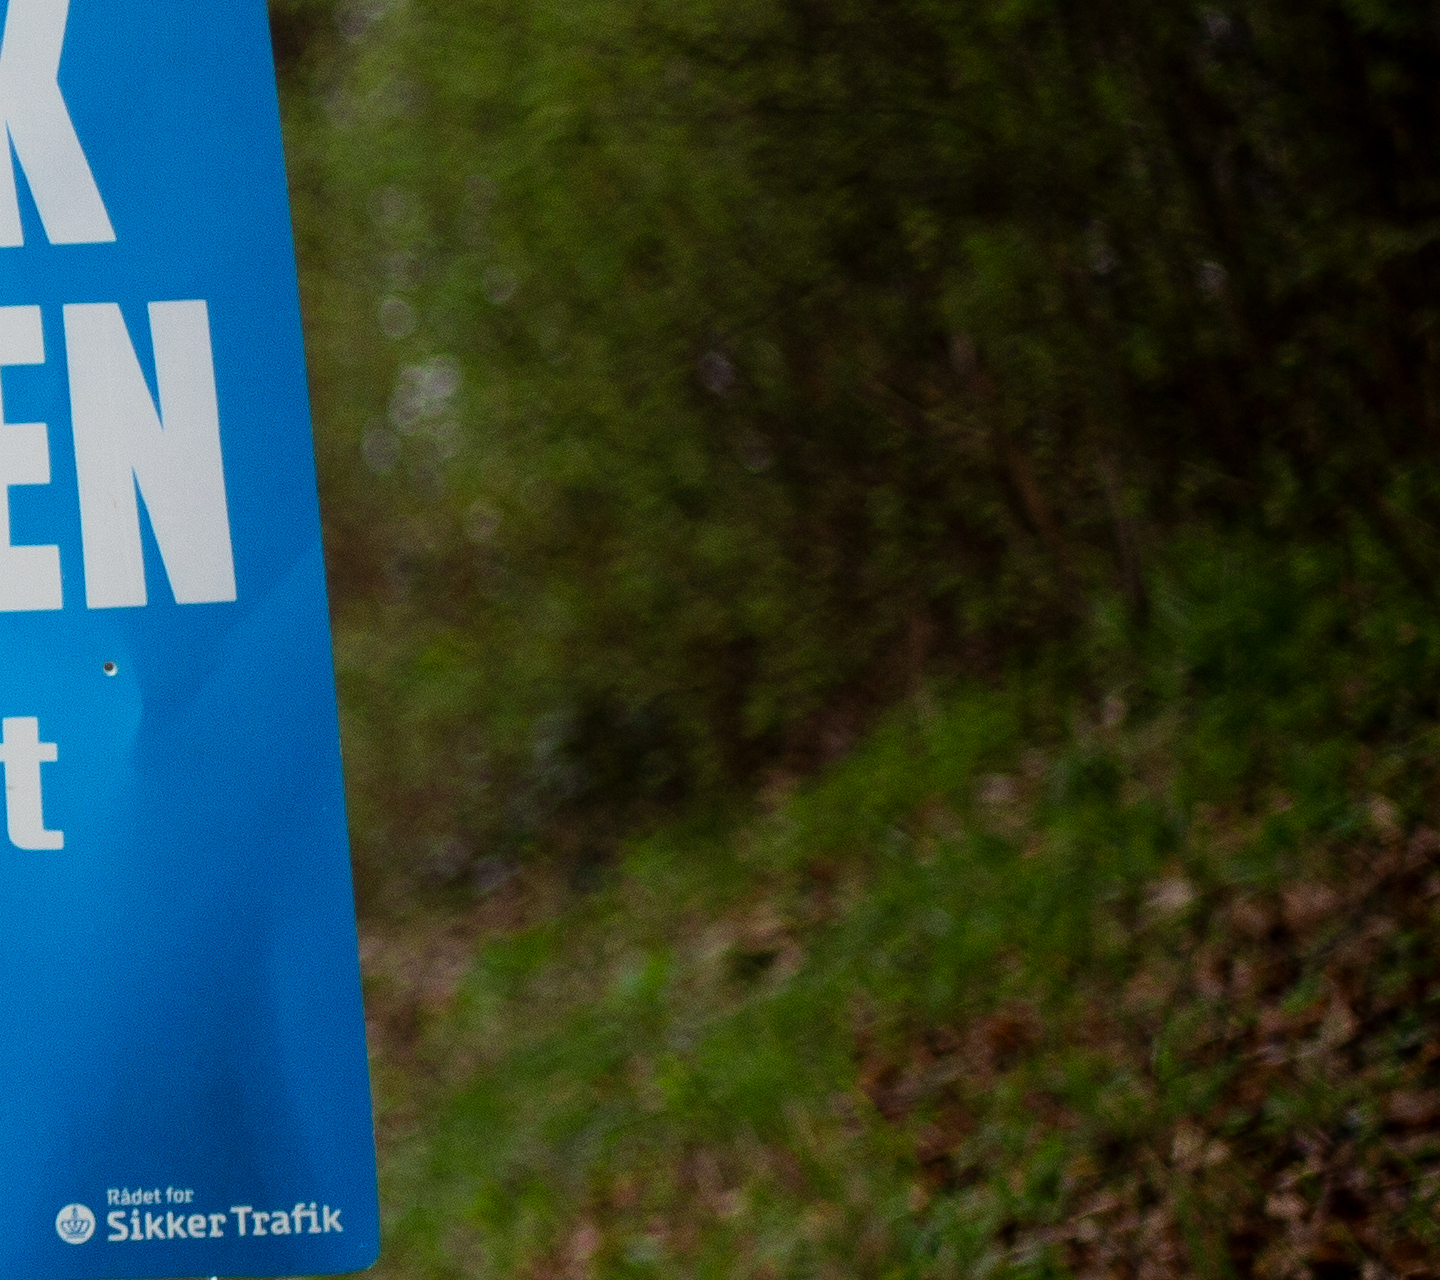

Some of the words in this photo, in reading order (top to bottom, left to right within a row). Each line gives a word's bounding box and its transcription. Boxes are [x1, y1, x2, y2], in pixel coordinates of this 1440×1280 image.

[106, 1187, 162, 1206] Rådet
[166, 1186, 195, 1204] for
[106, 1209, 228, 1242] Sikker
[229, 1202, 344, 1237] Trafik
